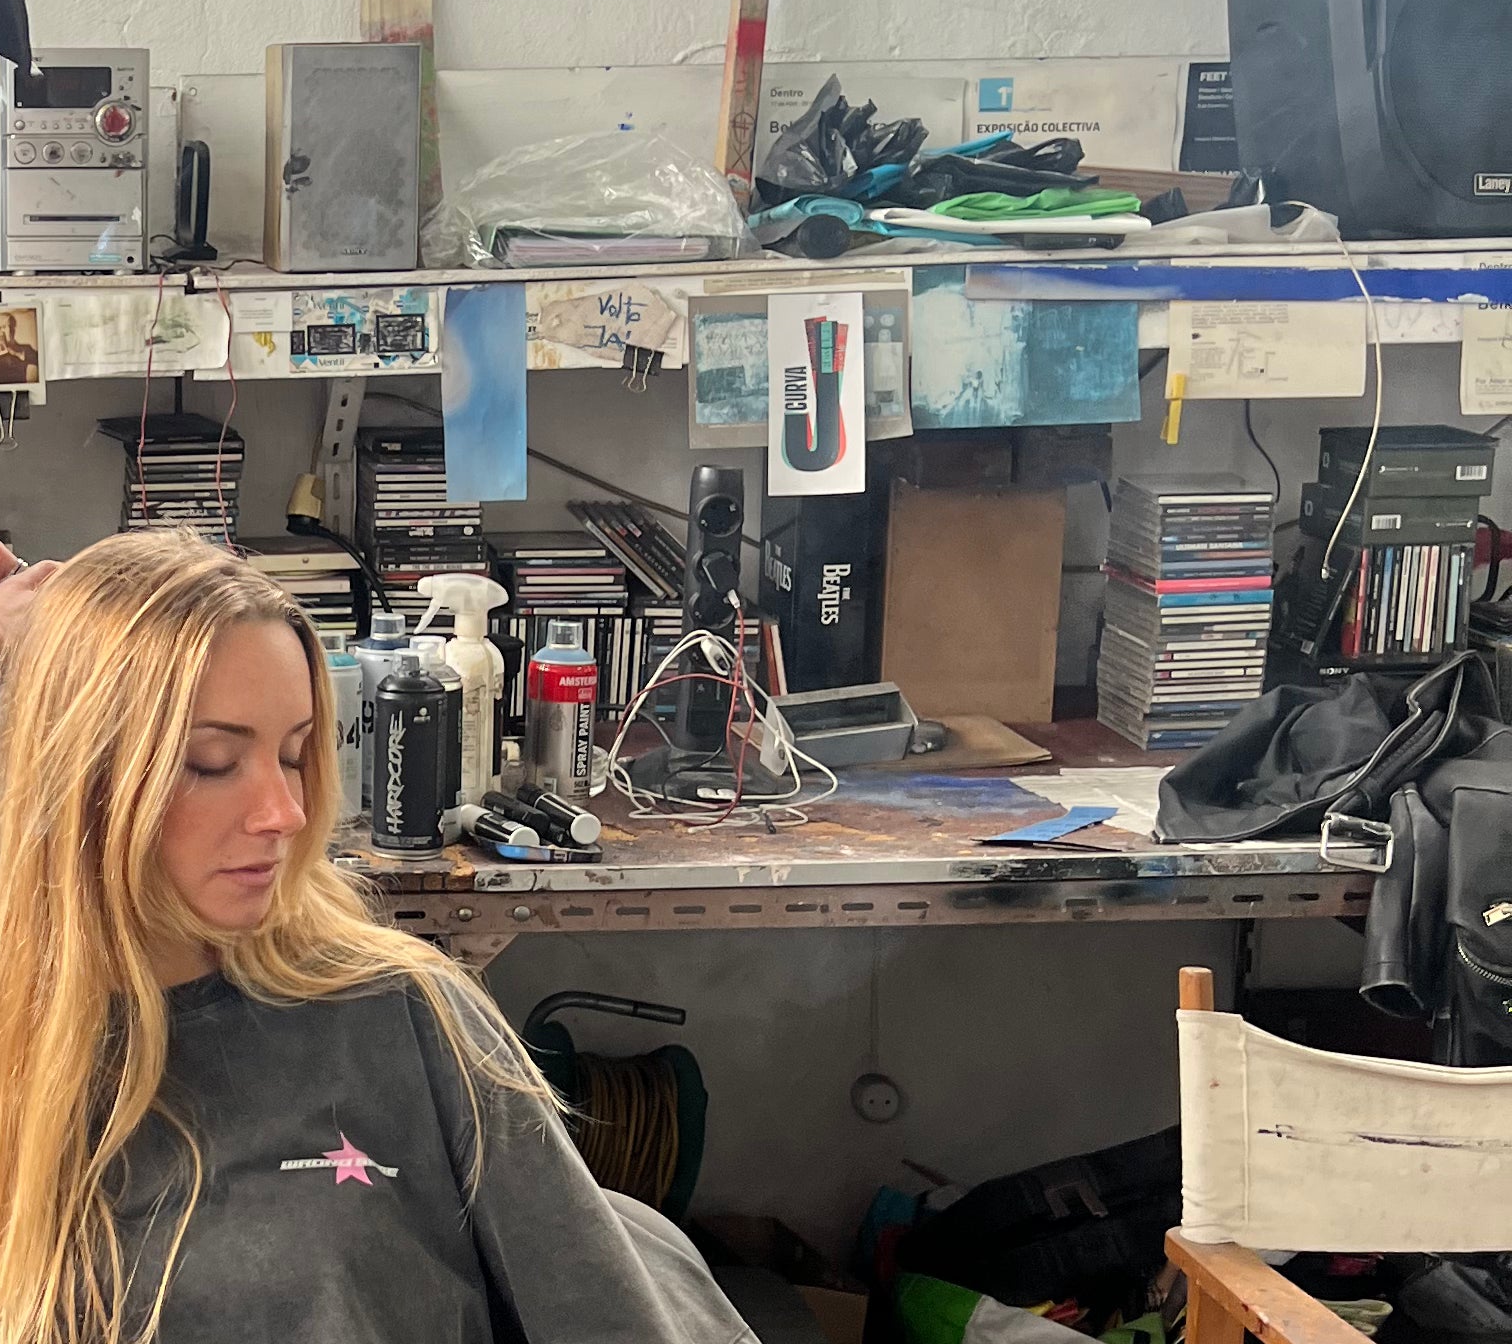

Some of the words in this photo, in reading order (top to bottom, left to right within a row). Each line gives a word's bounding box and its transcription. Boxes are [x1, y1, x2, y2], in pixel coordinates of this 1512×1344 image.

[770, 89, 804, 98] Dentro
[976, 120, 1039, 134] EXPOSIÇÃO
[1041, 121, 1101, 133] COLECTIVA
[1478, 175, 1511, 193] Laney
[784, 365, 808, 411] CURVA
[817, 563, 851, 625] BEATLES
[578, 703, 591, 737] PAINT
[386, 709, 407, 834] HARDCORE
[576, 739, 589, 777] SPRAY
